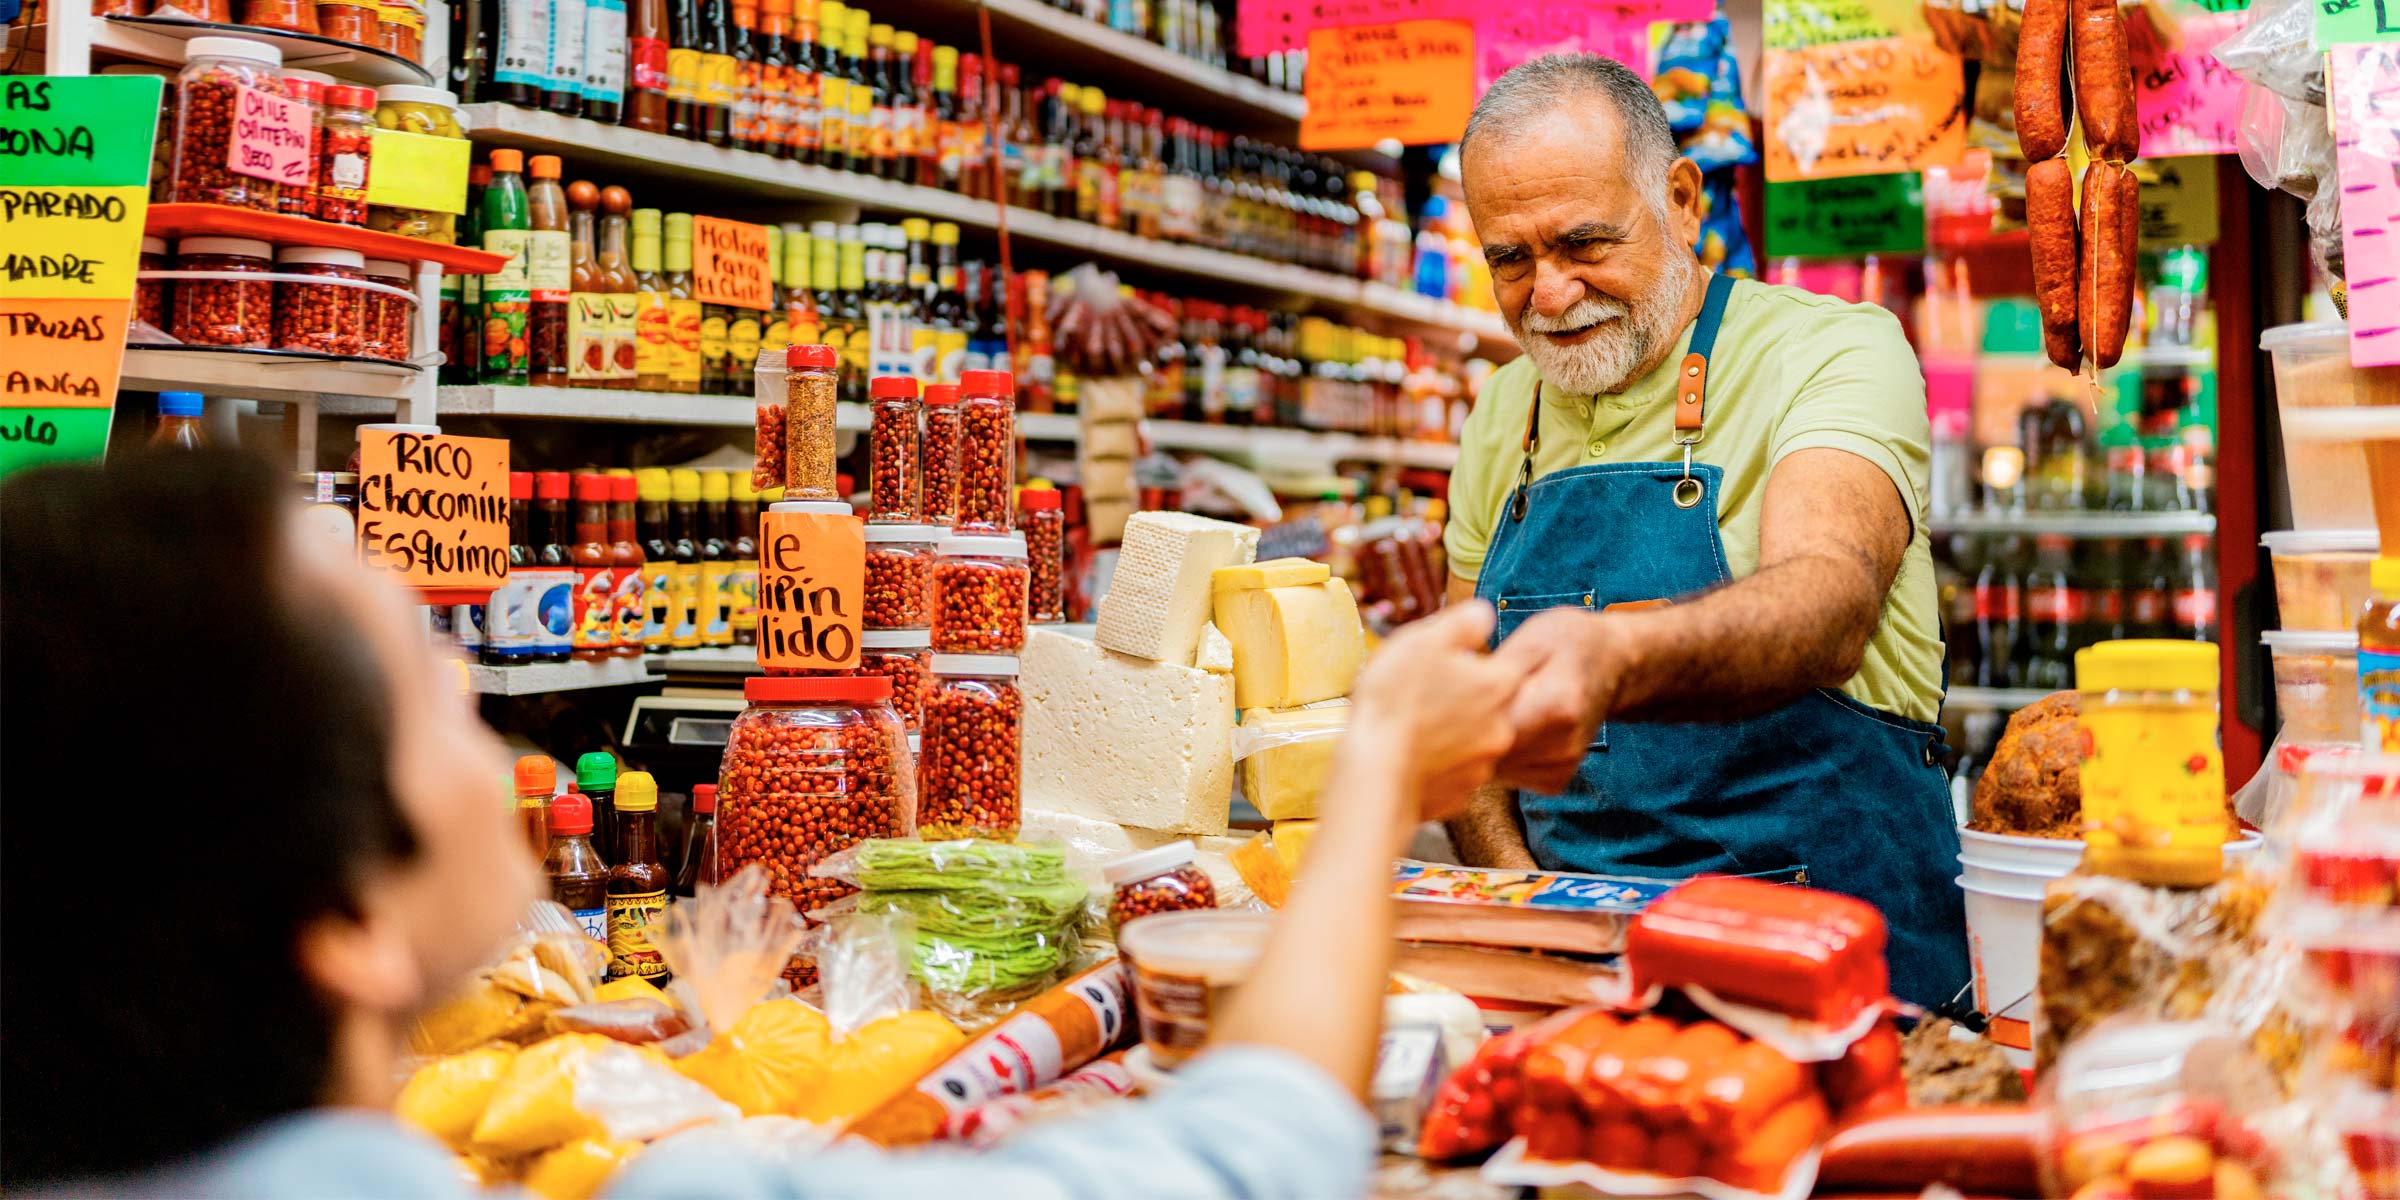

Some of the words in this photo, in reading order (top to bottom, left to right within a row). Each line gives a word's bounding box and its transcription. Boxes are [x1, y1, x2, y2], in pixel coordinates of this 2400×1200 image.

[245, 92, 289, 122] CHILE
[241, 144, 273, 170] SECO
[0, 190, 126, 222] PARADO
[0, 371, 100, 396] ANGA
[757, 614, 854, 663] lido
